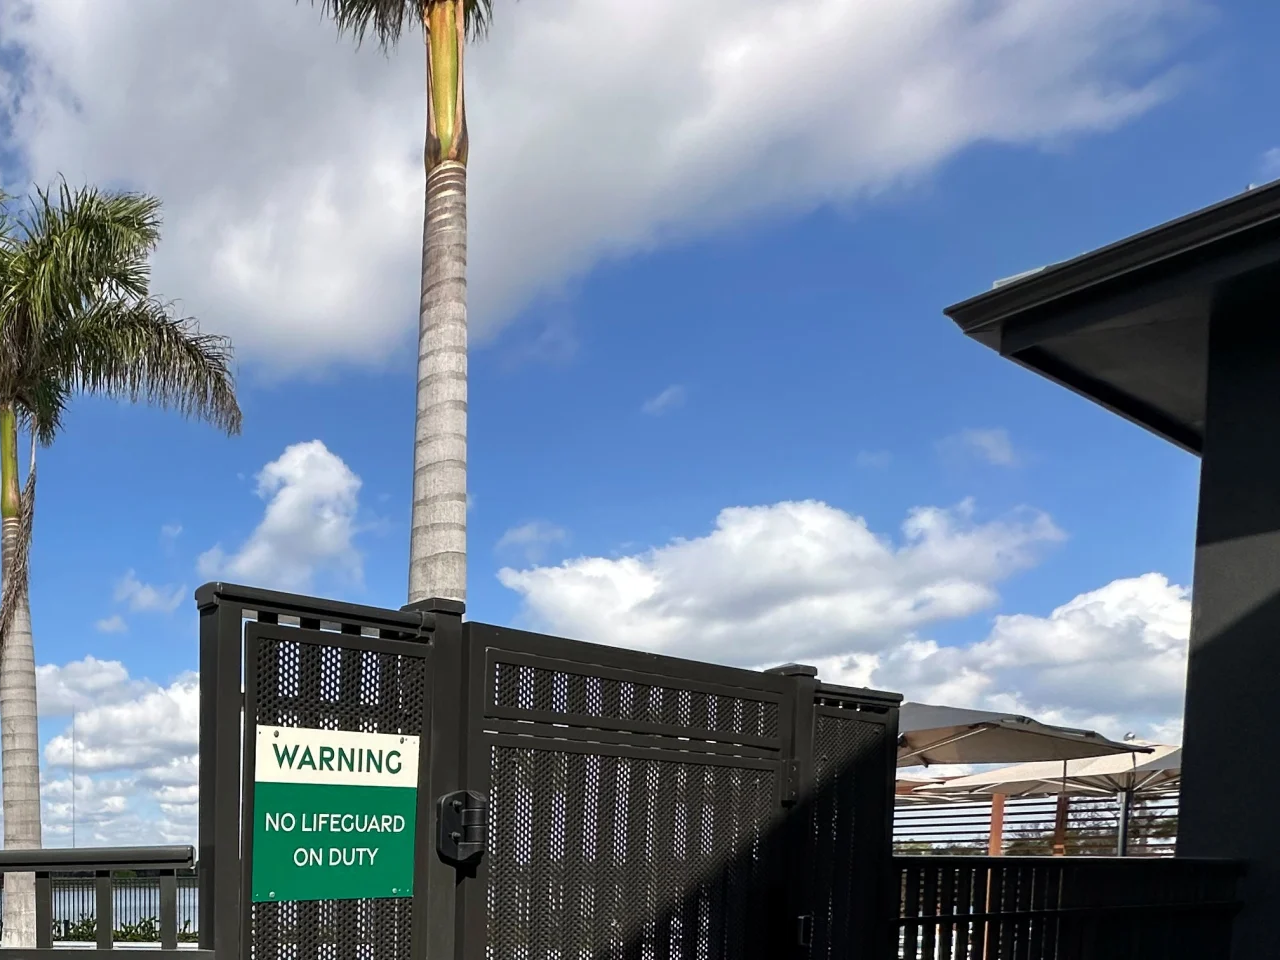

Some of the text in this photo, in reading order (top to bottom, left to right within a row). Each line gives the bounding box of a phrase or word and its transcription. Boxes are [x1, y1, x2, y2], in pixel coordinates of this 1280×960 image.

[272, 743, 402, 774] WARNING
[265, 812, 406, 833] NO LIFEGUARD
[293, 847, 379, 867] ON DUTY
